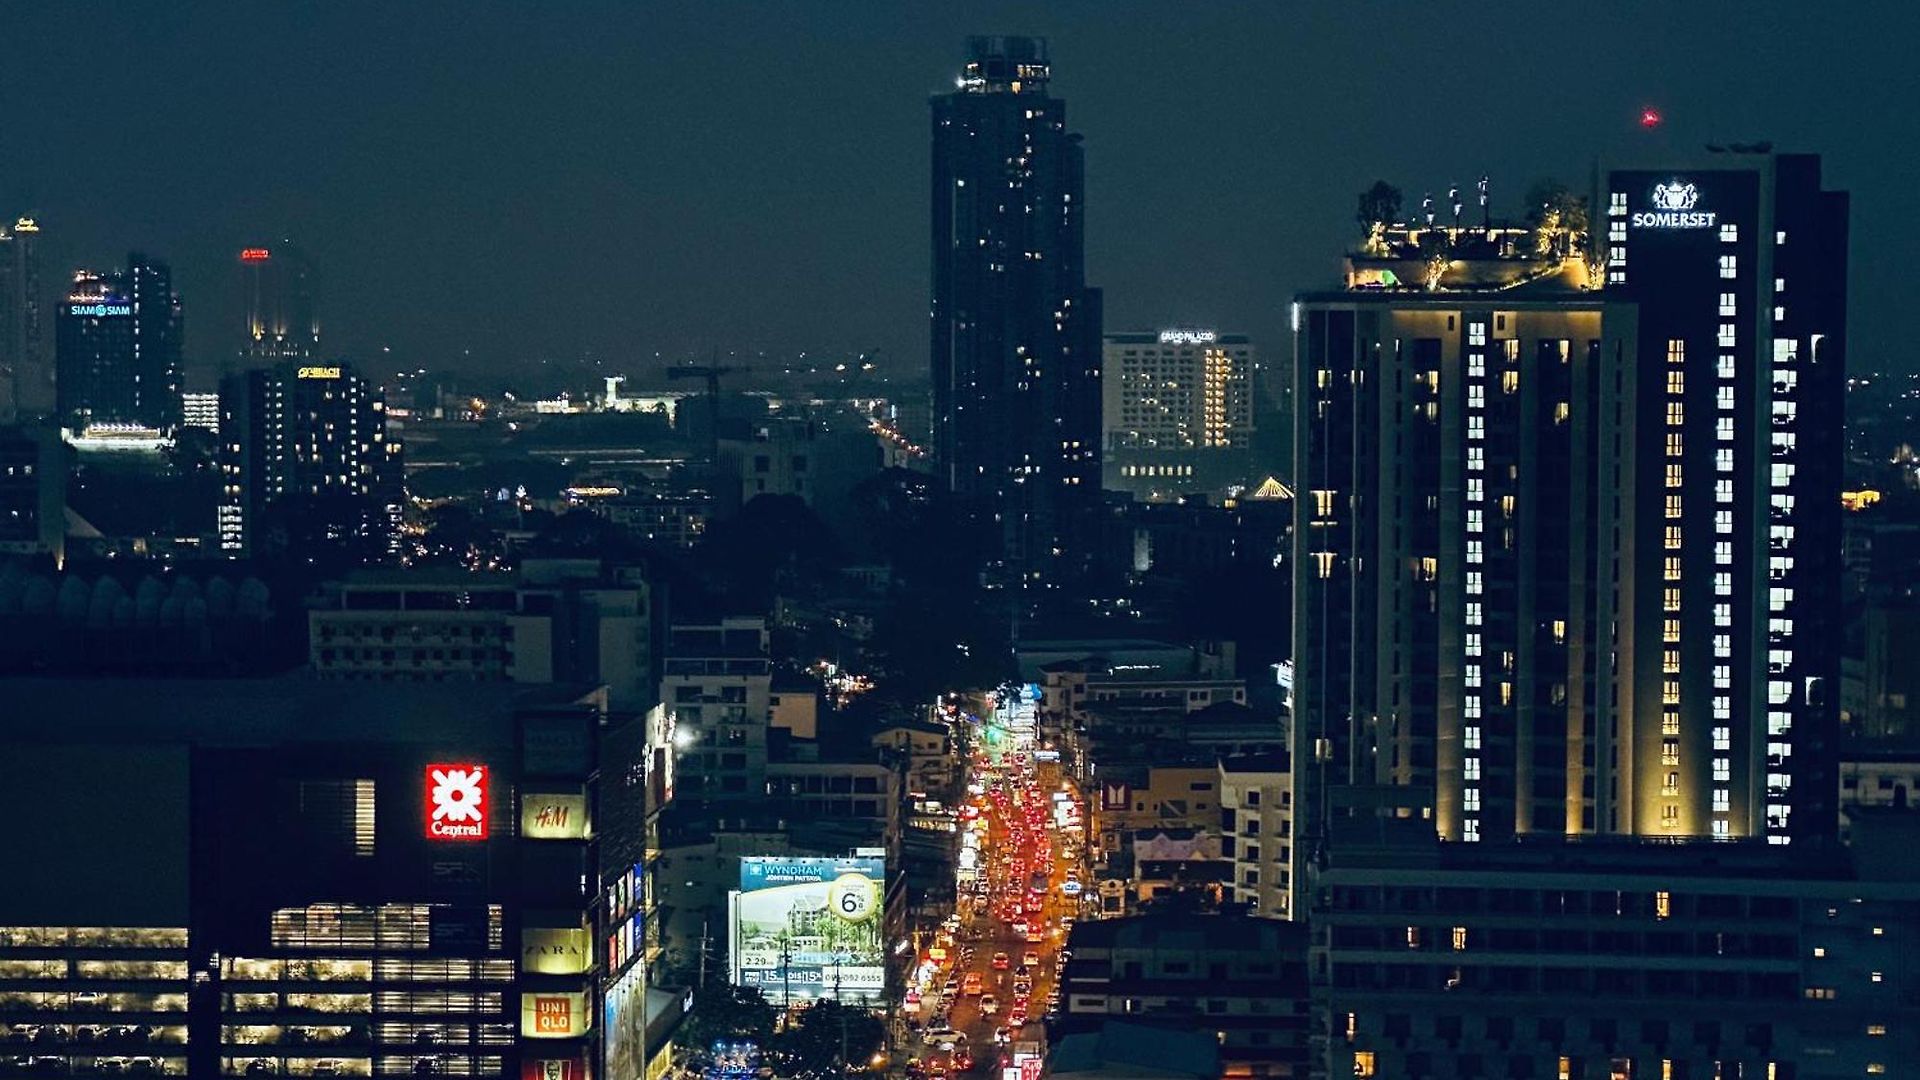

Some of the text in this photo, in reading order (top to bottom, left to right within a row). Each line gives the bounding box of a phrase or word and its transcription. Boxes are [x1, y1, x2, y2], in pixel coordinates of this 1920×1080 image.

[1632, 212, 1715, 227] SOMERSET
[107, 305, 130, 316] SIAM
[535, 806, 568, 828] H&M
[431, 821, 482, 837] Central
[764, 865, 823, 875] WYNDHAM
[525, 945, 579, 955] ZARA
[540, 1001, 566, 1013] UNI
[541, 1016, 568, 1030] QLO
